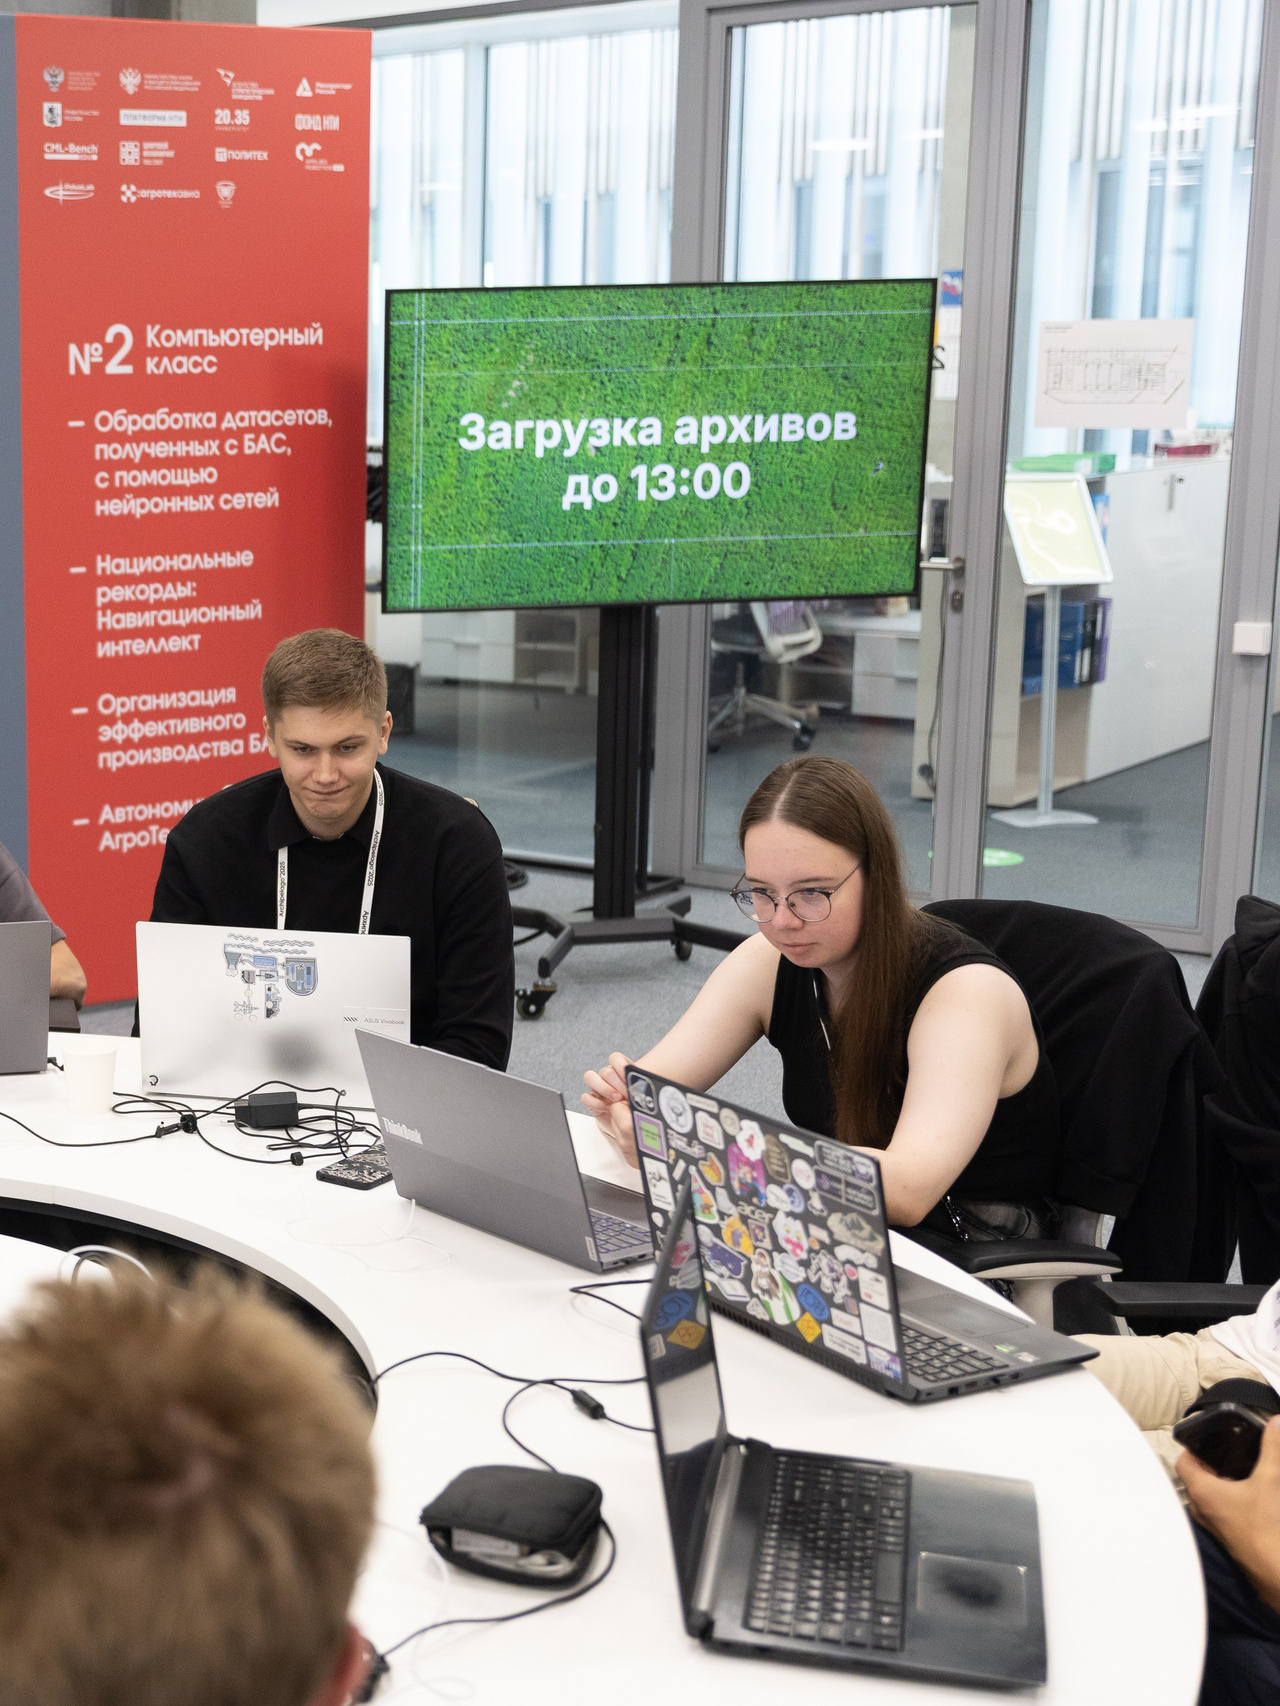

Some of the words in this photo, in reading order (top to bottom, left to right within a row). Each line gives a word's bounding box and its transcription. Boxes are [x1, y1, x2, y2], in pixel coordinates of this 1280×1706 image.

[214, 108, 251, 127] 20.35
[43, 142, 99, 154] CML-Bench
[227, 150, 269, 161] ПОЛИТЕХ
[146, 322, 323, 351] Компьютерный
[146, 354, 218, 375] класс
[94, 407, 217, 436] Обработка
[220, 408, 333, 431] датасетов,
[458, 411, 663, 459] Загрузка
[673, 411, 858, 454] архивов
[94, 439, 221, 464] полученных
[224, 438, 239, 456] с
[243, 432, 292, 456] БАС,
[94, 471, 110, 489] с
[114, 466, 219, 488] помощью
[561, 472, 619, 511] до
[629, 460, 752, 502] 13:00
[95, 493, 215, 519] нейронных
[218, 487, 280, 511] сетей
[96, 549, 255, 576] Национальные
[96, 581, 197, 607] рекорды:
[96, 599, 263, 631] Навигационный
[96, 633, 202, 658] интеллект
[97, 687, 237, 717] Организация
[98, 711, 247, 744] эффективного
[97, 740, 245, 772] производства
[382, 1116, 424, 1145] ThinkBook
[736, 1200, 775, 1225] acer
